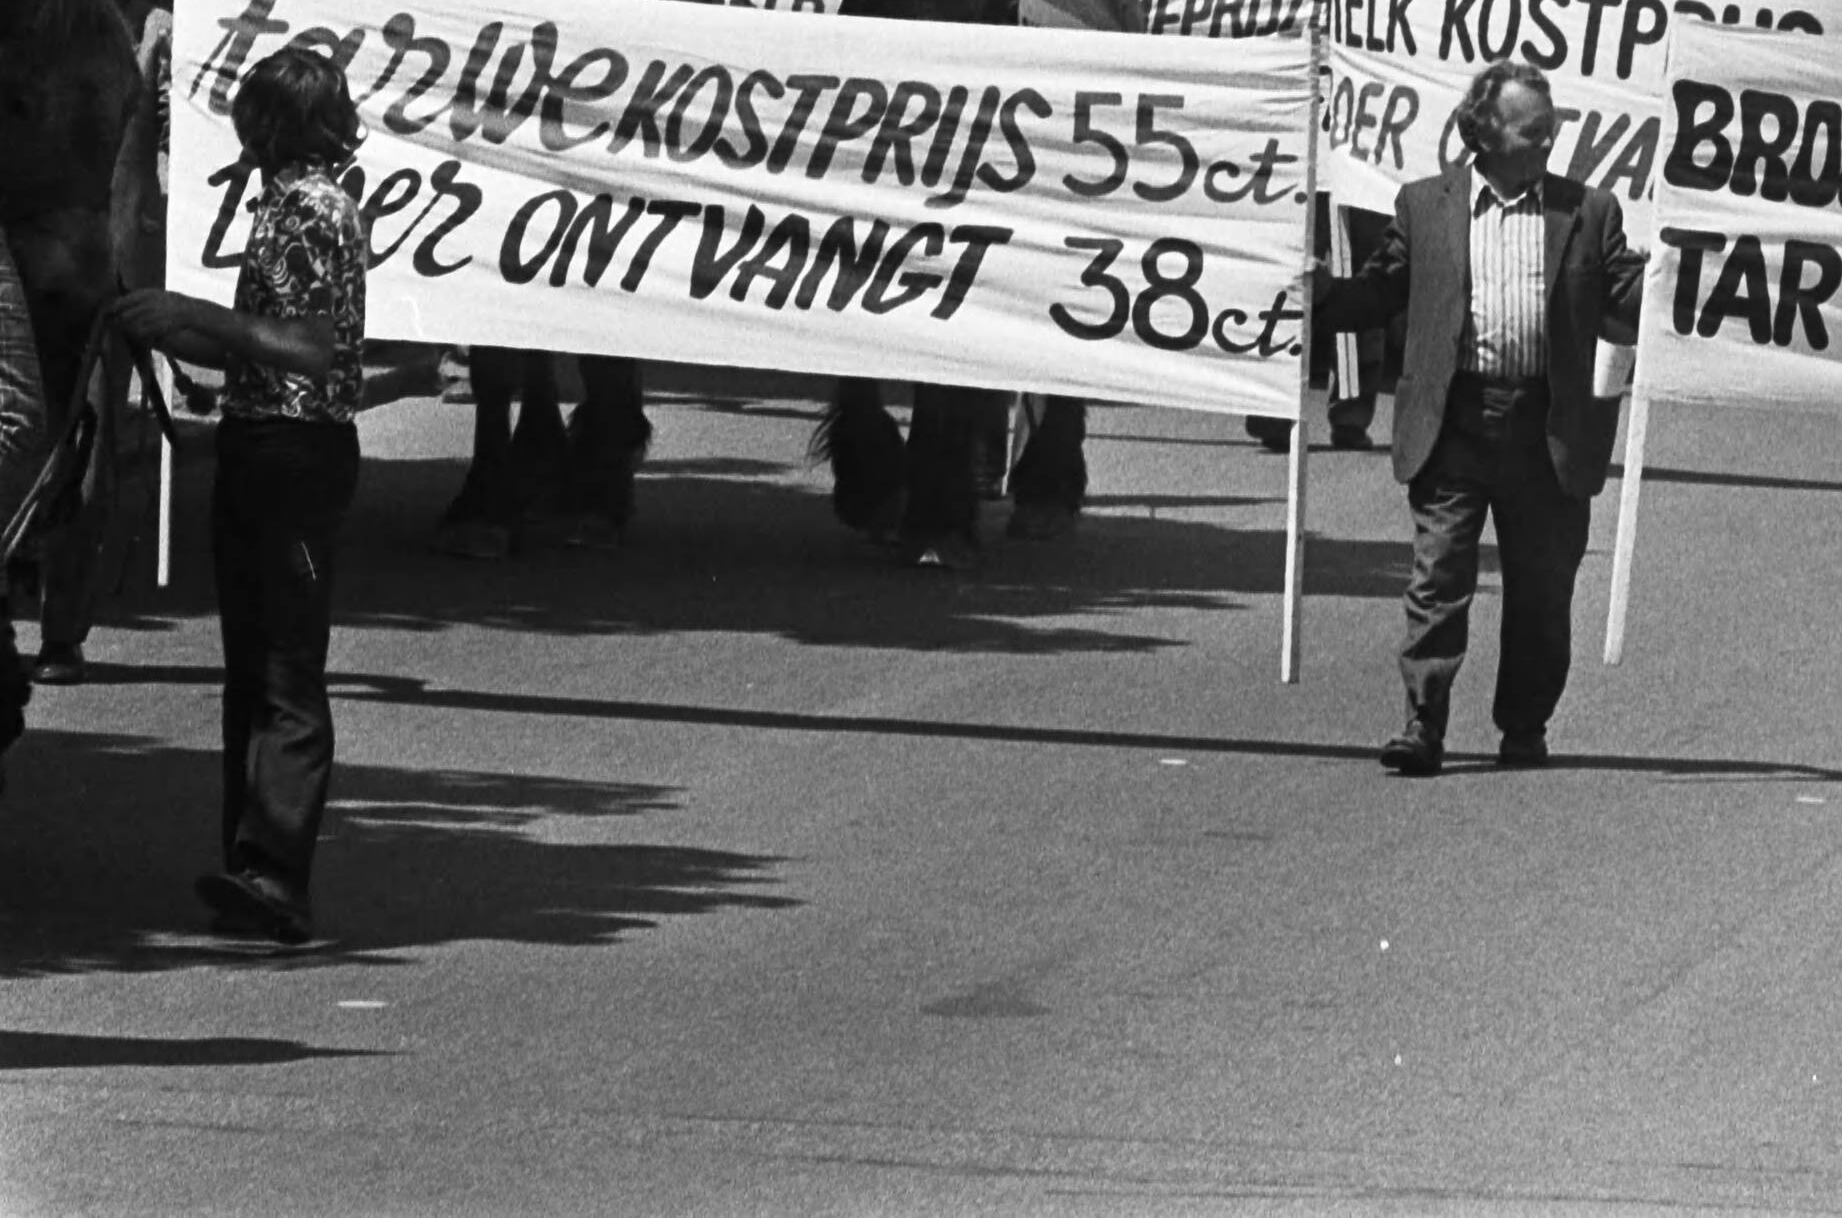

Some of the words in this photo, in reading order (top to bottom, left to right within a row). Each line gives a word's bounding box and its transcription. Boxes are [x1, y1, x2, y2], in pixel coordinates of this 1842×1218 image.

[607, 58, 1053, 209] KOSTPRIJS
[1318, 65, 1420, 170] OER
[500, 189, 1014, 320] ONTVANGT
